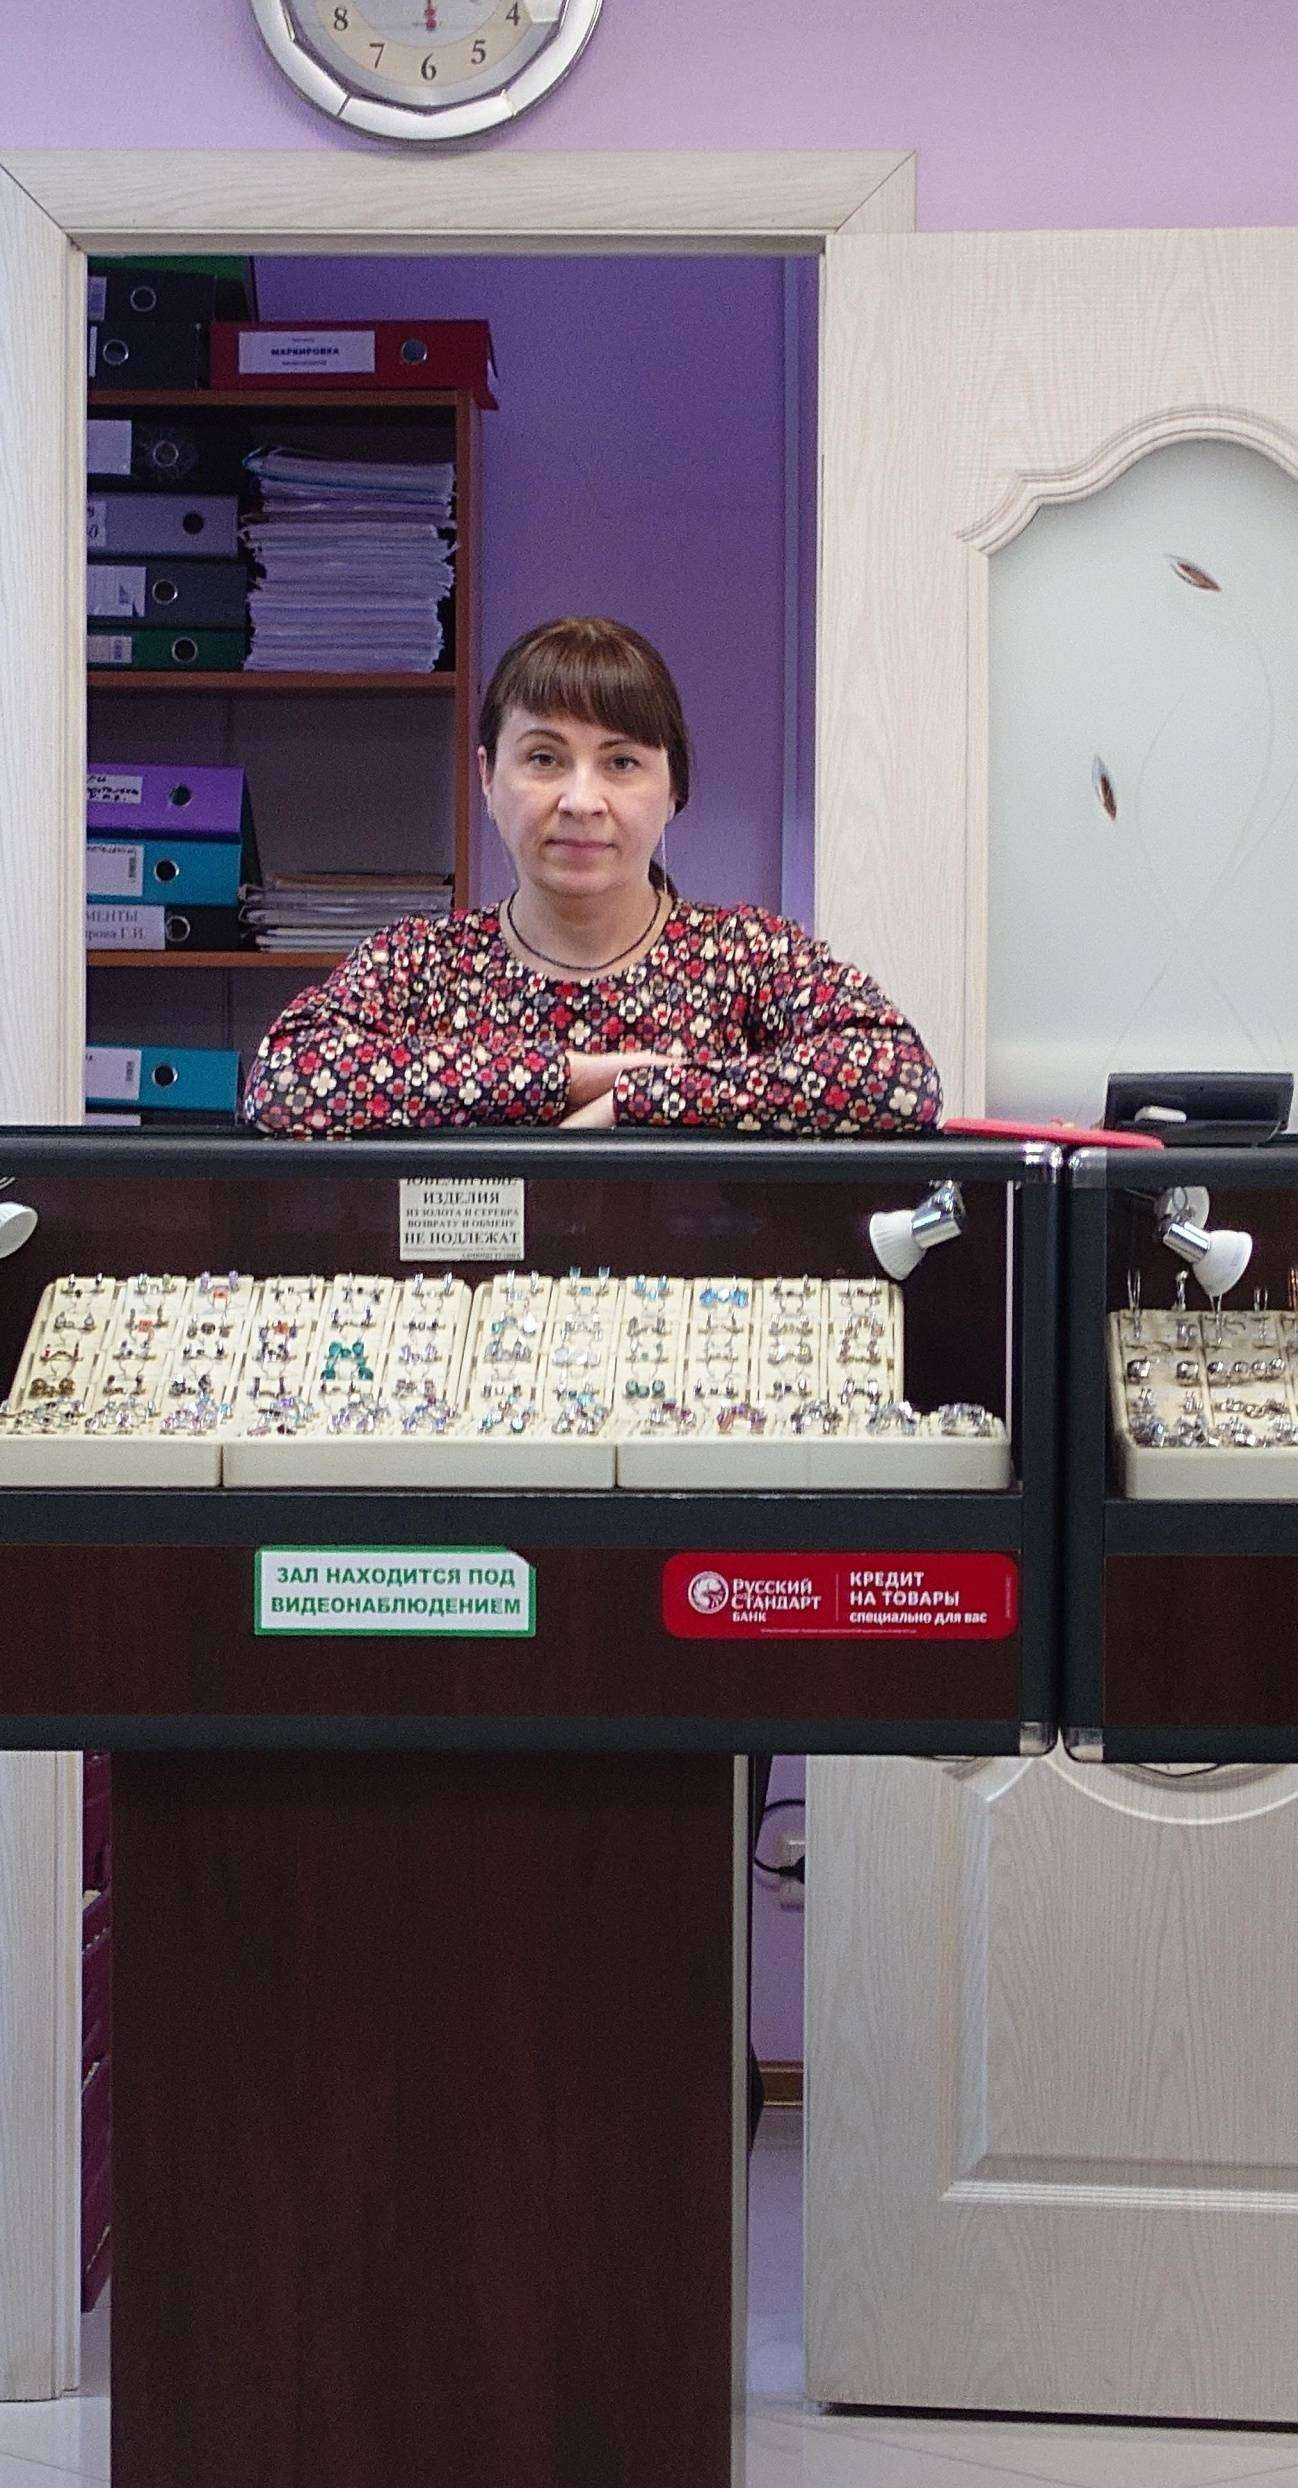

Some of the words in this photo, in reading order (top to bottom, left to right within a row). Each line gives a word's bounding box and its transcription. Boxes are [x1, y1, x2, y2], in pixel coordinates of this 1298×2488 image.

[333, 7, 349, 32] 8
[505, 3, 520, 26] 4
[369, 42, 385, 69] 7
[470, 40, 487, 65] 5
[420, 52, 437, 82] 6
[270, 348, 339, 356] МАРКИРОВКА
[423, 1191, 500, 1205] ИЗДЕЛИЯ
[406, 1208, 420, 1217] ИЗ
[422, 1208, 461, 1217] ЗОЛОТА
[464, 1208, 472, 1217] И
[474, 1208, 520, 1217] СЕРЕБРА
[408, 1219, 459, 1228] ВОЗВРАТУ
[462, 1219, 470, 1228] И
[471, 1219, 516, 1228] ОБМЕНУ
[404, 1232, 426, 1244] НЕ
[430, 1231, 520, 1246] ПОДЛЕЖАТ
[277, 1567, 319, 1585] ЗАЛ
[326, 1567, 461, 1587] НАХОДИТСЯ
[468, 1568, 516, 1588] ПОД
[849, 1571, 925, 1589] КРЕДИТ
[732, 1578, 812, 1595] РУССКИЙ
[731, 1594, 822, 1610] СТАНДАРТ
[849, 1590, 876, 1606] НА
[881, 1590, 960, 1606] ТОВАРЫ
[271, 1597, 521, 1616] ВИДЕОНАБЛЮДЕНИЕМ
[732, 1611, 767, 1623] БАНК
[849, 1611, 932, 1625] специально
[934, 1612, 961, 1626] для
[964, 1612, 988, 1623] вас
